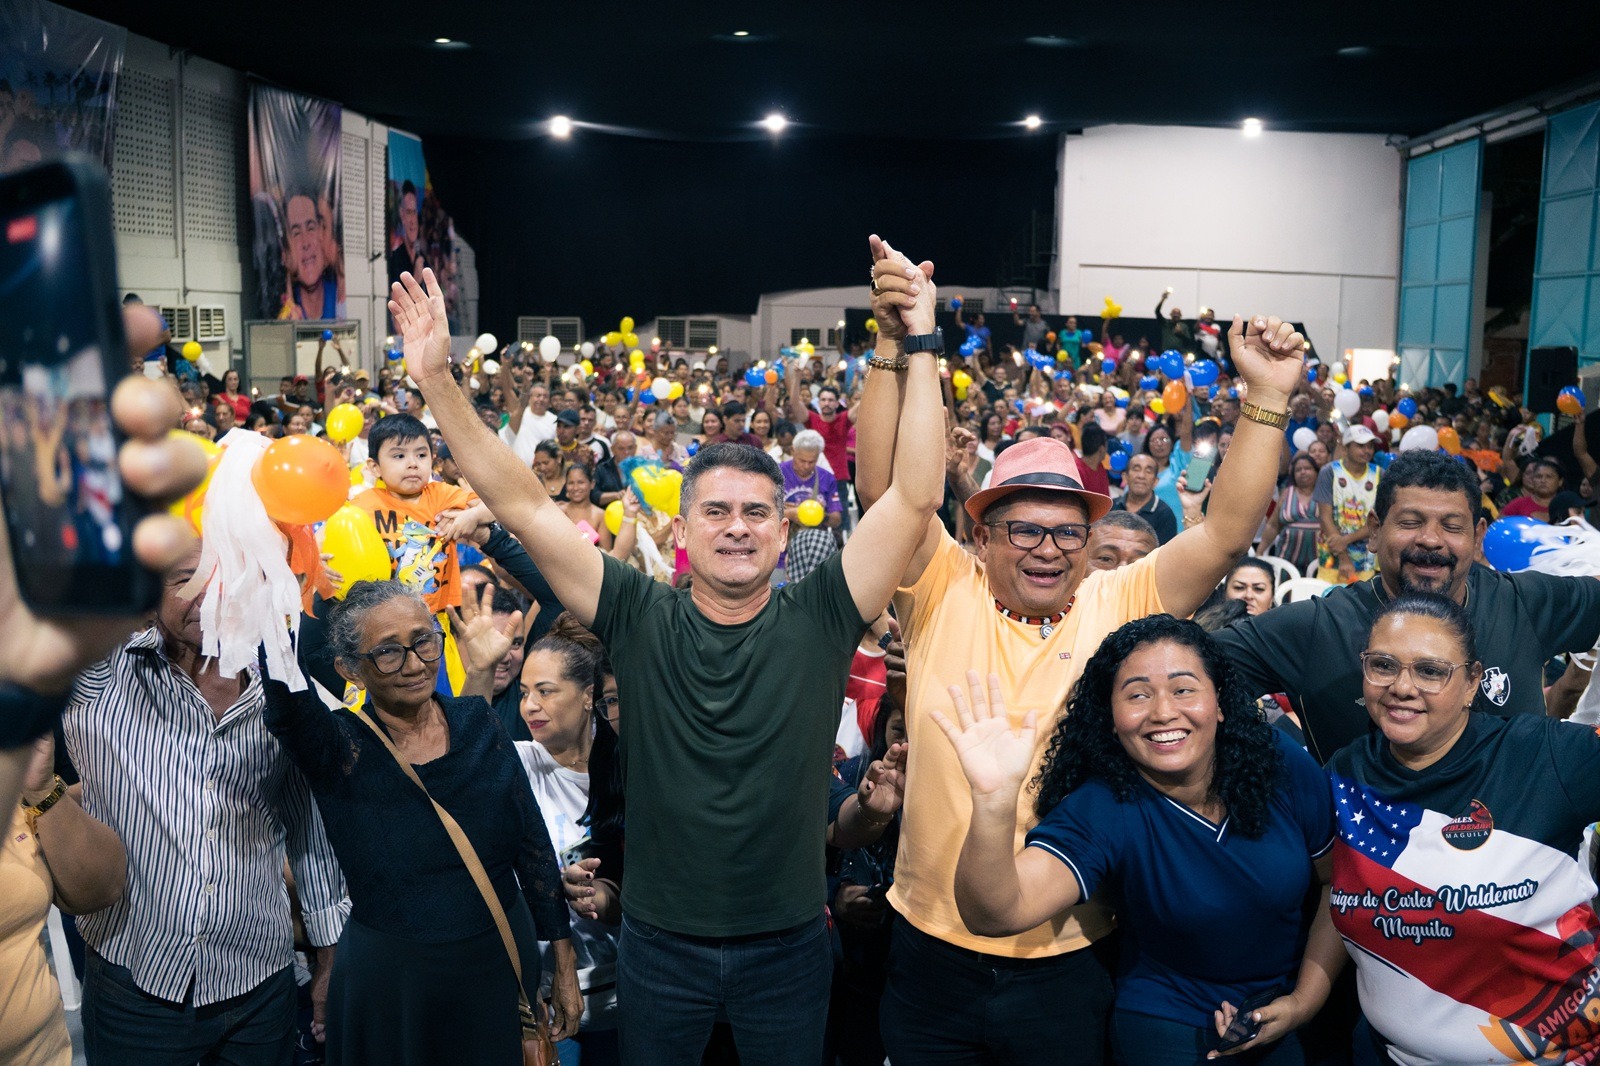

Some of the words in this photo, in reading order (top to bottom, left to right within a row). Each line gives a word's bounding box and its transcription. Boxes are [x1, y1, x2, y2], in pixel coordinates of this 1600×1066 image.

[1445, 830, 1489, 839] MAGUILA
[1384, 888, 1434, 911] Carles
[1438, 880, 1537, 912] Waldemar
[1373, 916, 1453, 944] Maguila
[1537, 978, 1595, 1042] AMIGOS
